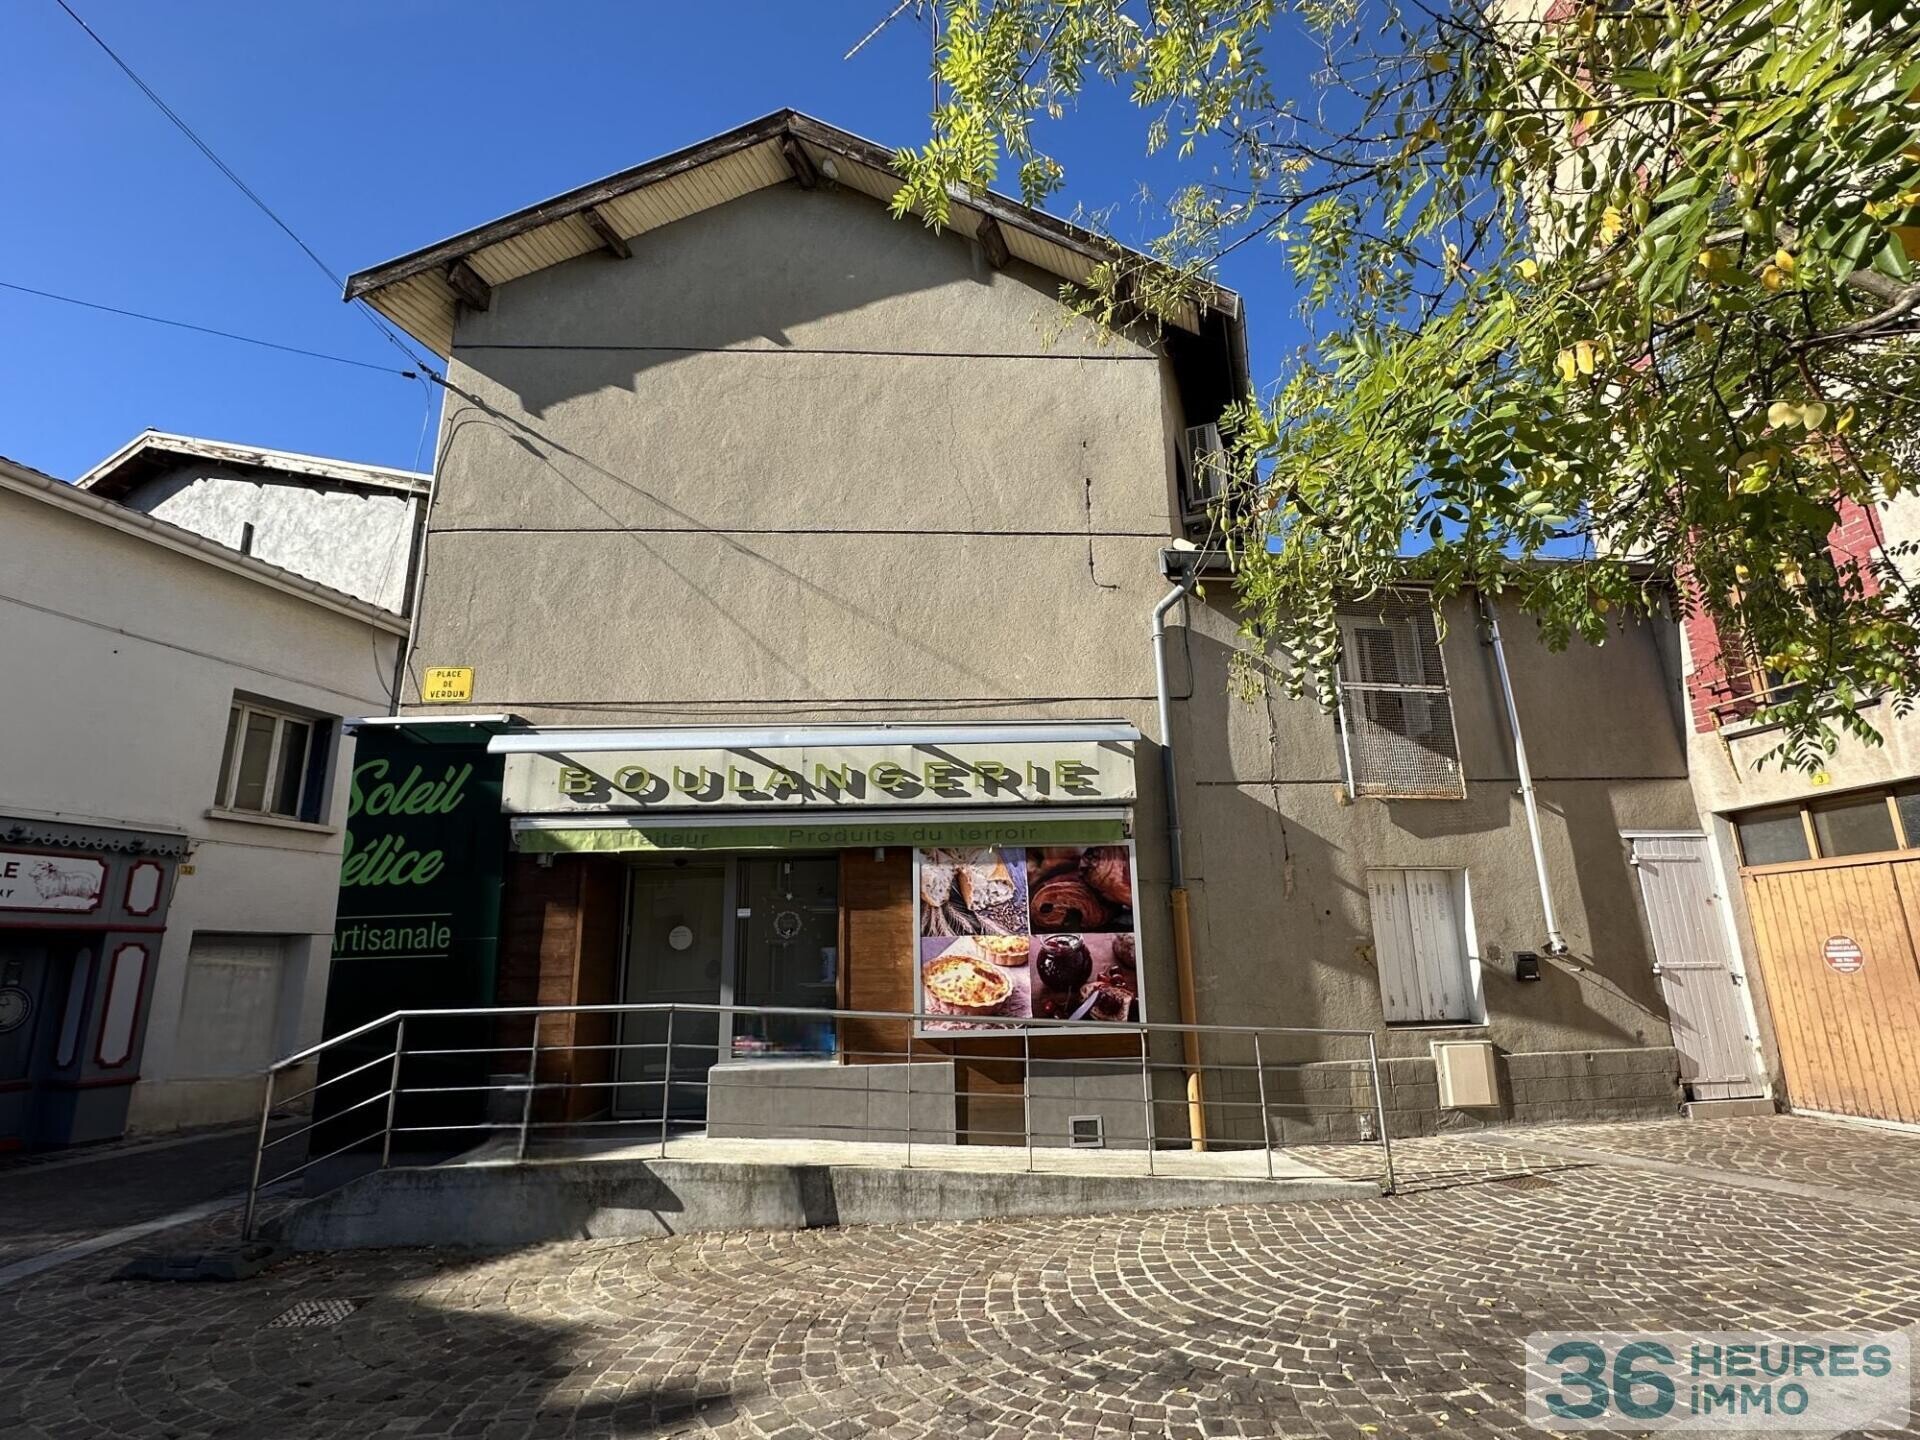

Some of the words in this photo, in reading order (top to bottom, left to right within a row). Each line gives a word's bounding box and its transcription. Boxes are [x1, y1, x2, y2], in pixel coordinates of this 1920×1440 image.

[436, 670, 462, 678] PLACE
[443, 680, 453, 688] DE
[430, 690, 465, 698] VERDUN
[558, 759, 1086, 793] BOULANGERIE
[1818, 775, 1824, 784] 3
[348, 759, 473, 816] Soleil
[615, 830, 710, 847] Traiteur
[788, 827, 896, 844] Produits
[912, 826, 943, 842] du
[959, 825, 1038, 841] terroir
[340, 830, 445, 886] élice
